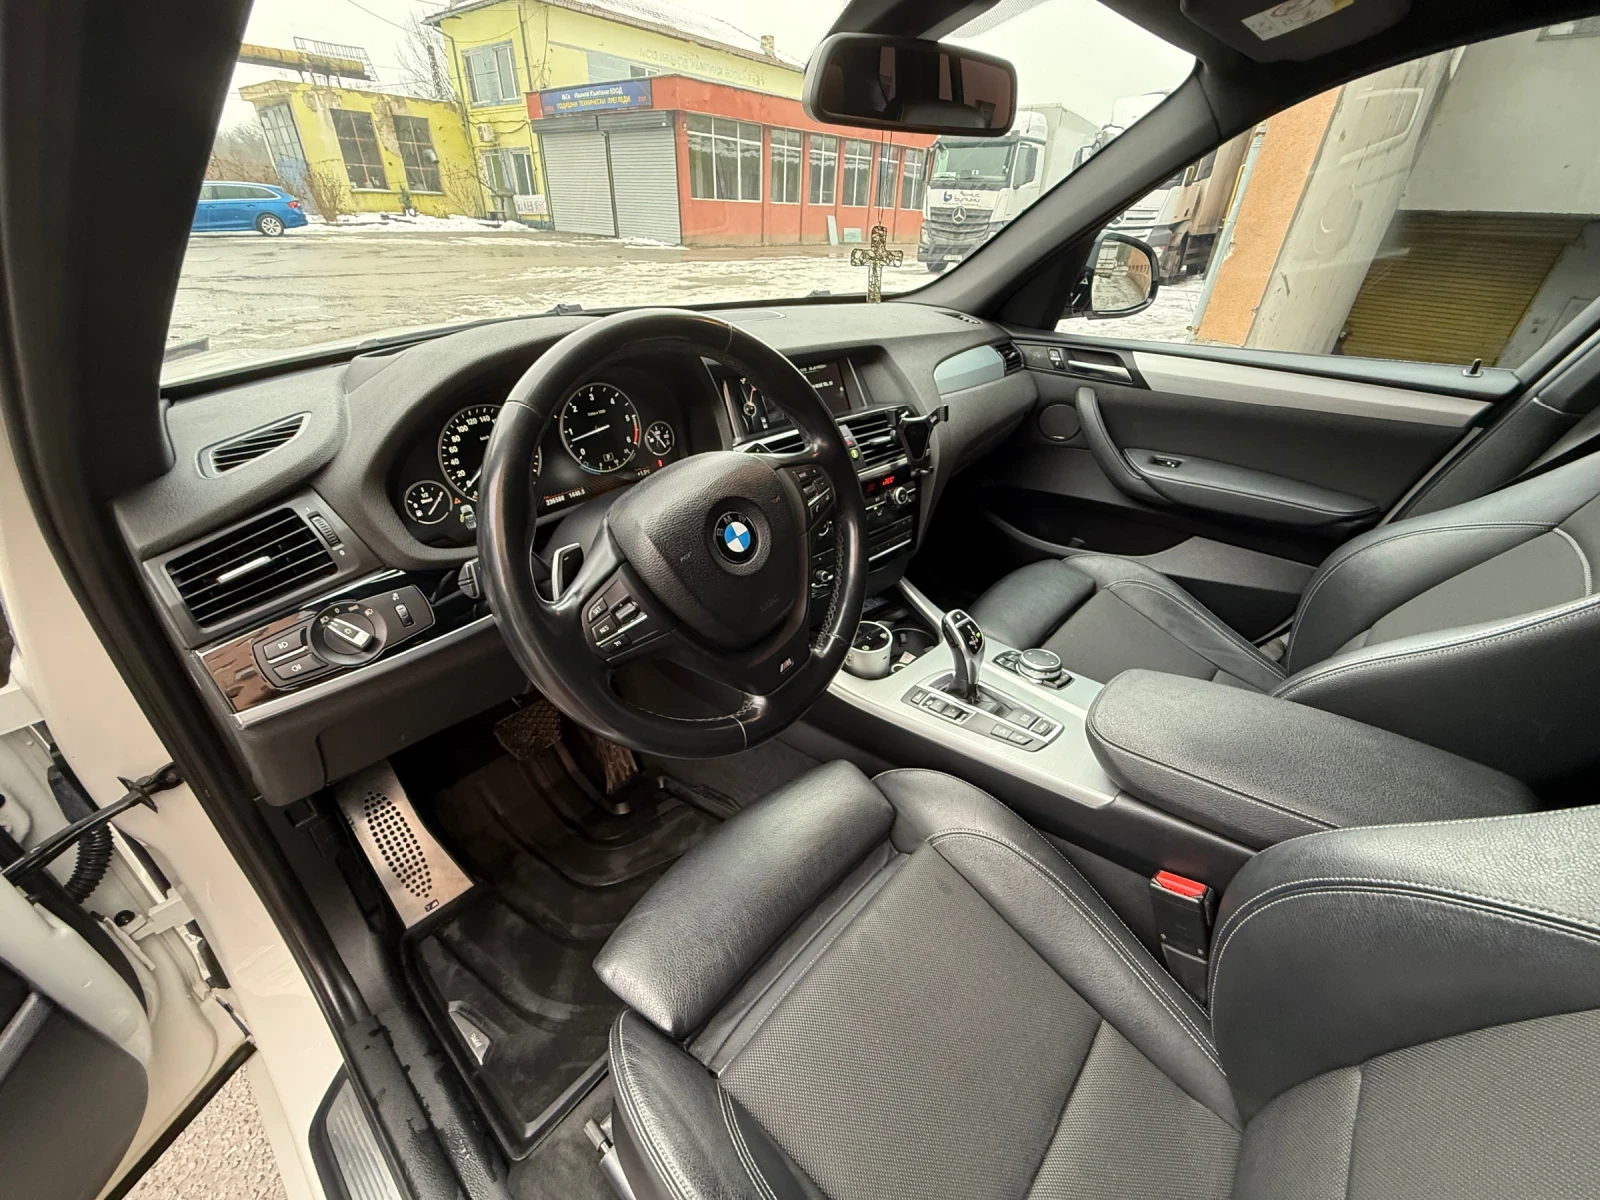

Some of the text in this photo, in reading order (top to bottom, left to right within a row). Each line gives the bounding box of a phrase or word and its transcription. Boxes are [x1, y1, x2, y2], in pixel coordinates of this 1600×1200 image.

[588, 393, 595, 401] 3
[610, 397, 616, 405] 4
[572, 405, 578, 413] 2
[466, 417, 478, 426] 120
[479, 415, 491, 423] 140
[625, 414, 630, 422] 5
[456, 424, 469, 433] 100
[568, 428, 574, 436] 1
[451, 434, 461, 443] 80
[626, 435, 632, 443] 6
[448, 445, 459, 454] 60
[580, 448, 586, 456] 0
[450, 457, 460, 466] 40
[456, 469, 466, 478] 20
[716, 514, 747, 537] BMW
[592, 605, 602, 615] SET
[599, 624, 610, 634] RES
